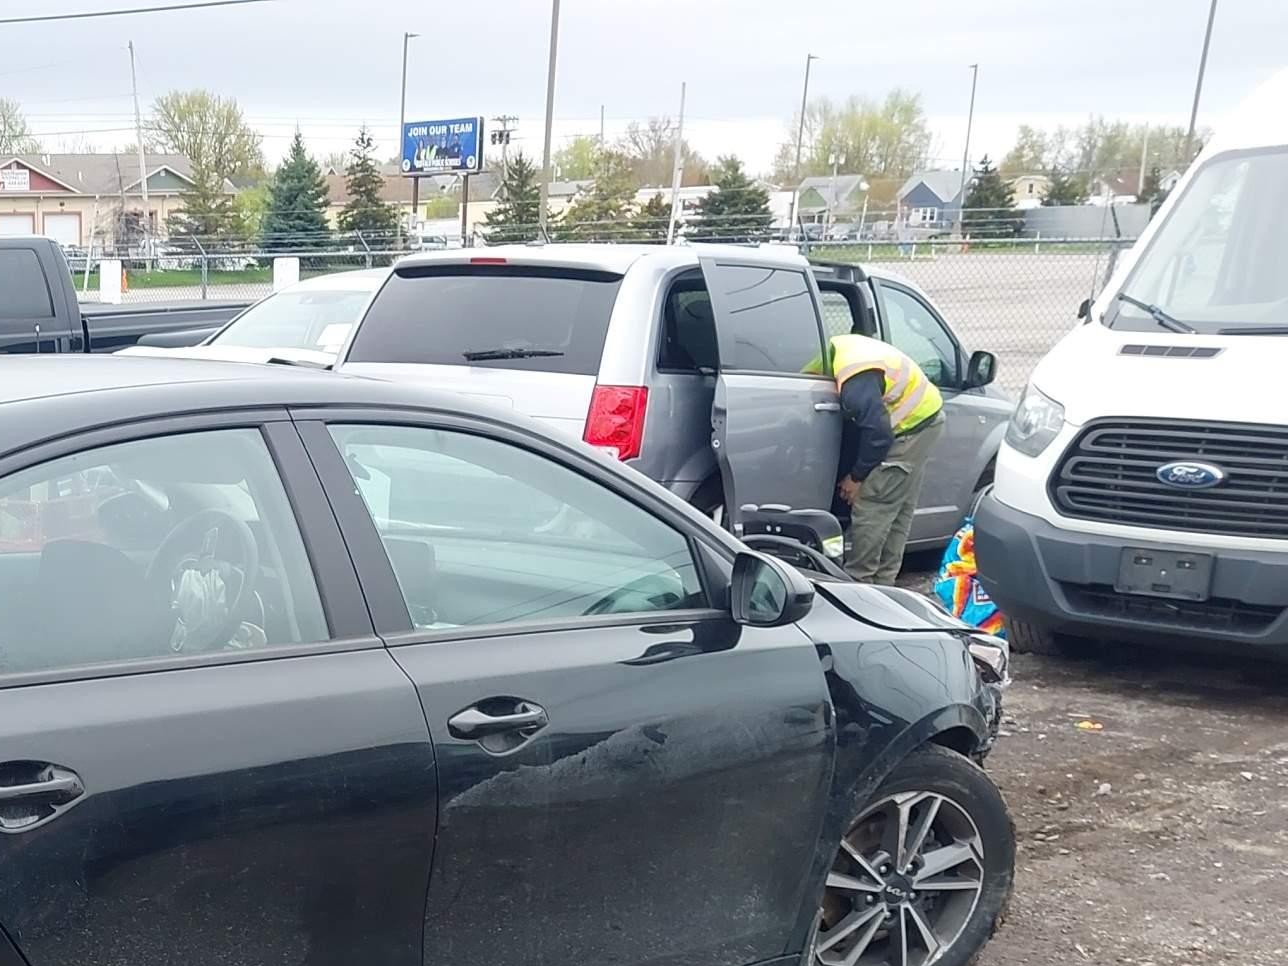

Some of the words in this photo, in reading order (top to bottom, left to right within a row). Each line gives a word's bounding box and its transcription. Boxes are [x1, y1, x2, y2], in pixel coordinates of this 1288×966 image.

[408, 127, 428, 137] JOIN
[429, 125, 447, 136] OUR
[449, 123, 473, 134] TEAM
[1168, 466, 1206, 483] Ford
